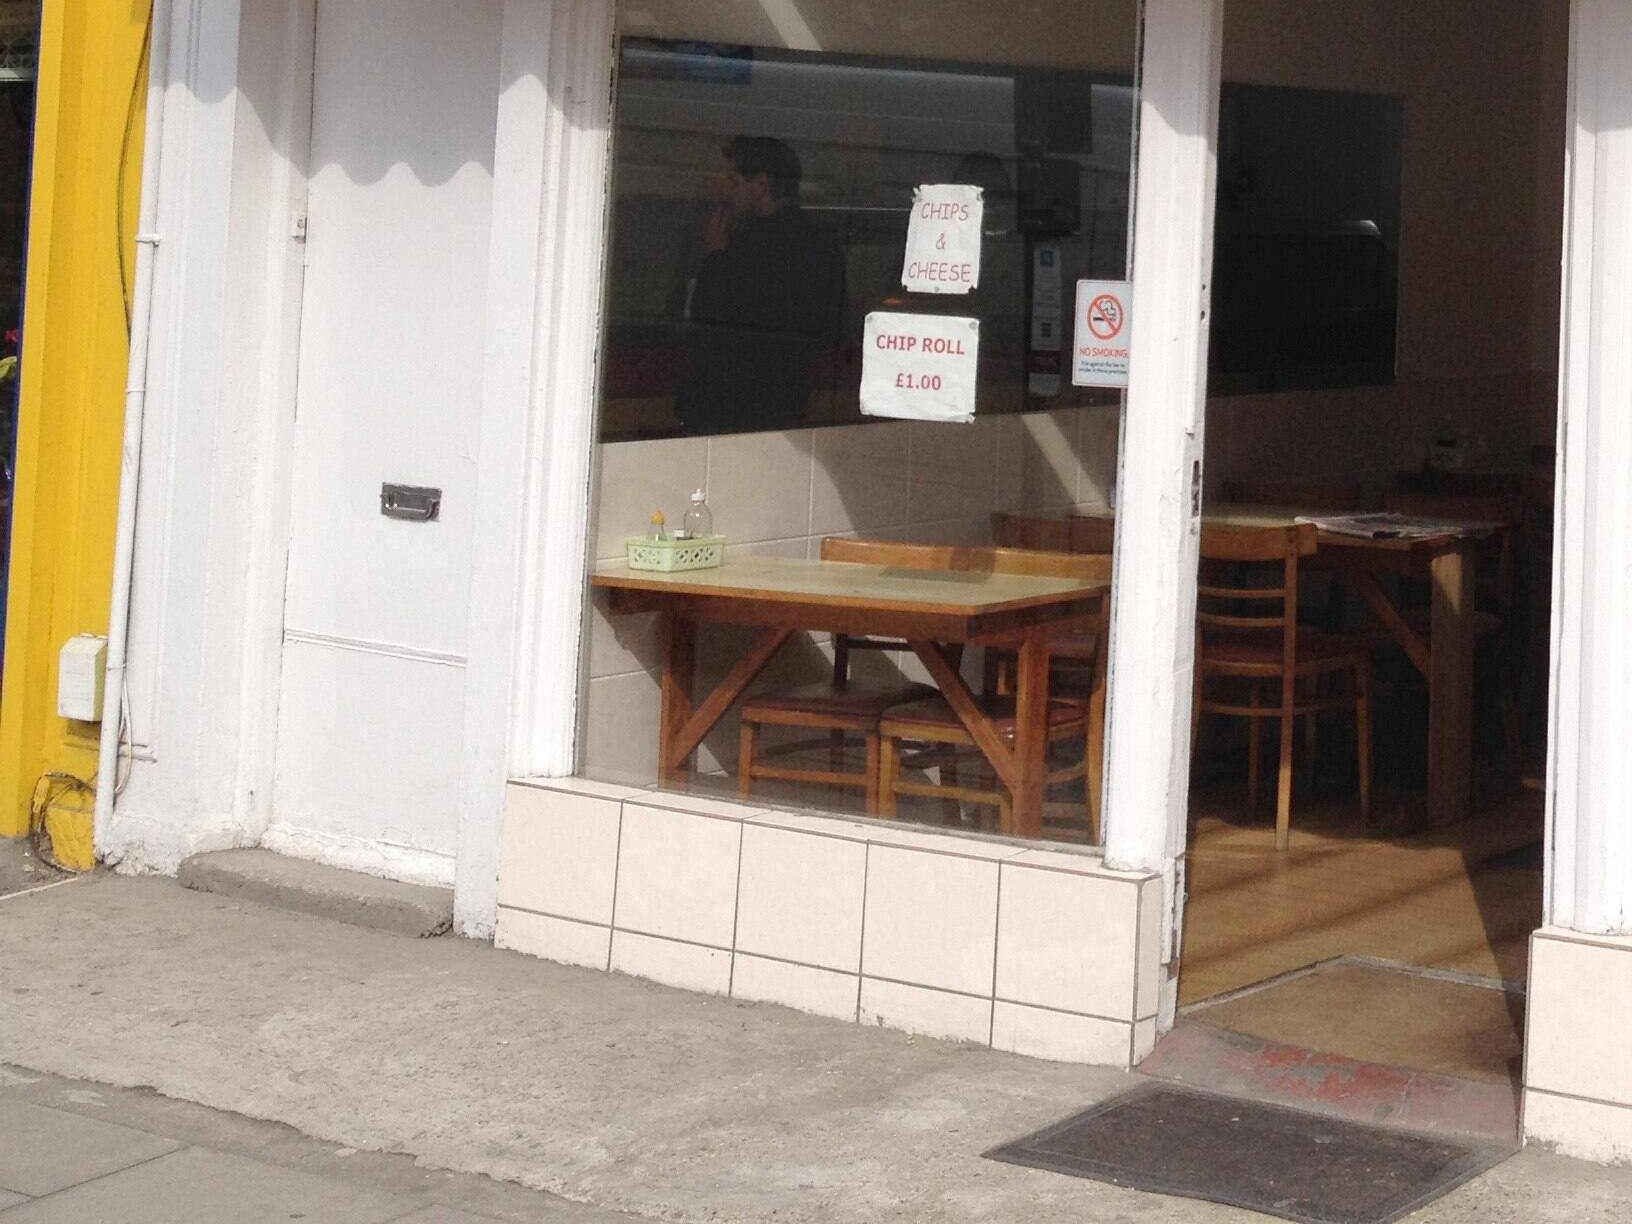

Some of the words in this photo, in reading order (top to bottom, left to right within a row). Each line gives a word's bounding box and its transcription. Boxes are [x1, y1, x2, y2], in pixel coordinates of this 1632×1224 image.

[920, 202, 969, 222] CHIPS
[936, 232, 946, 250] &
[907, 262, 972, 283] CHEESE
[876, 334, 917, 352] CHIP
[922, 337, 966, 355] ROLL
[895, 373, 942, 391] £1.00
